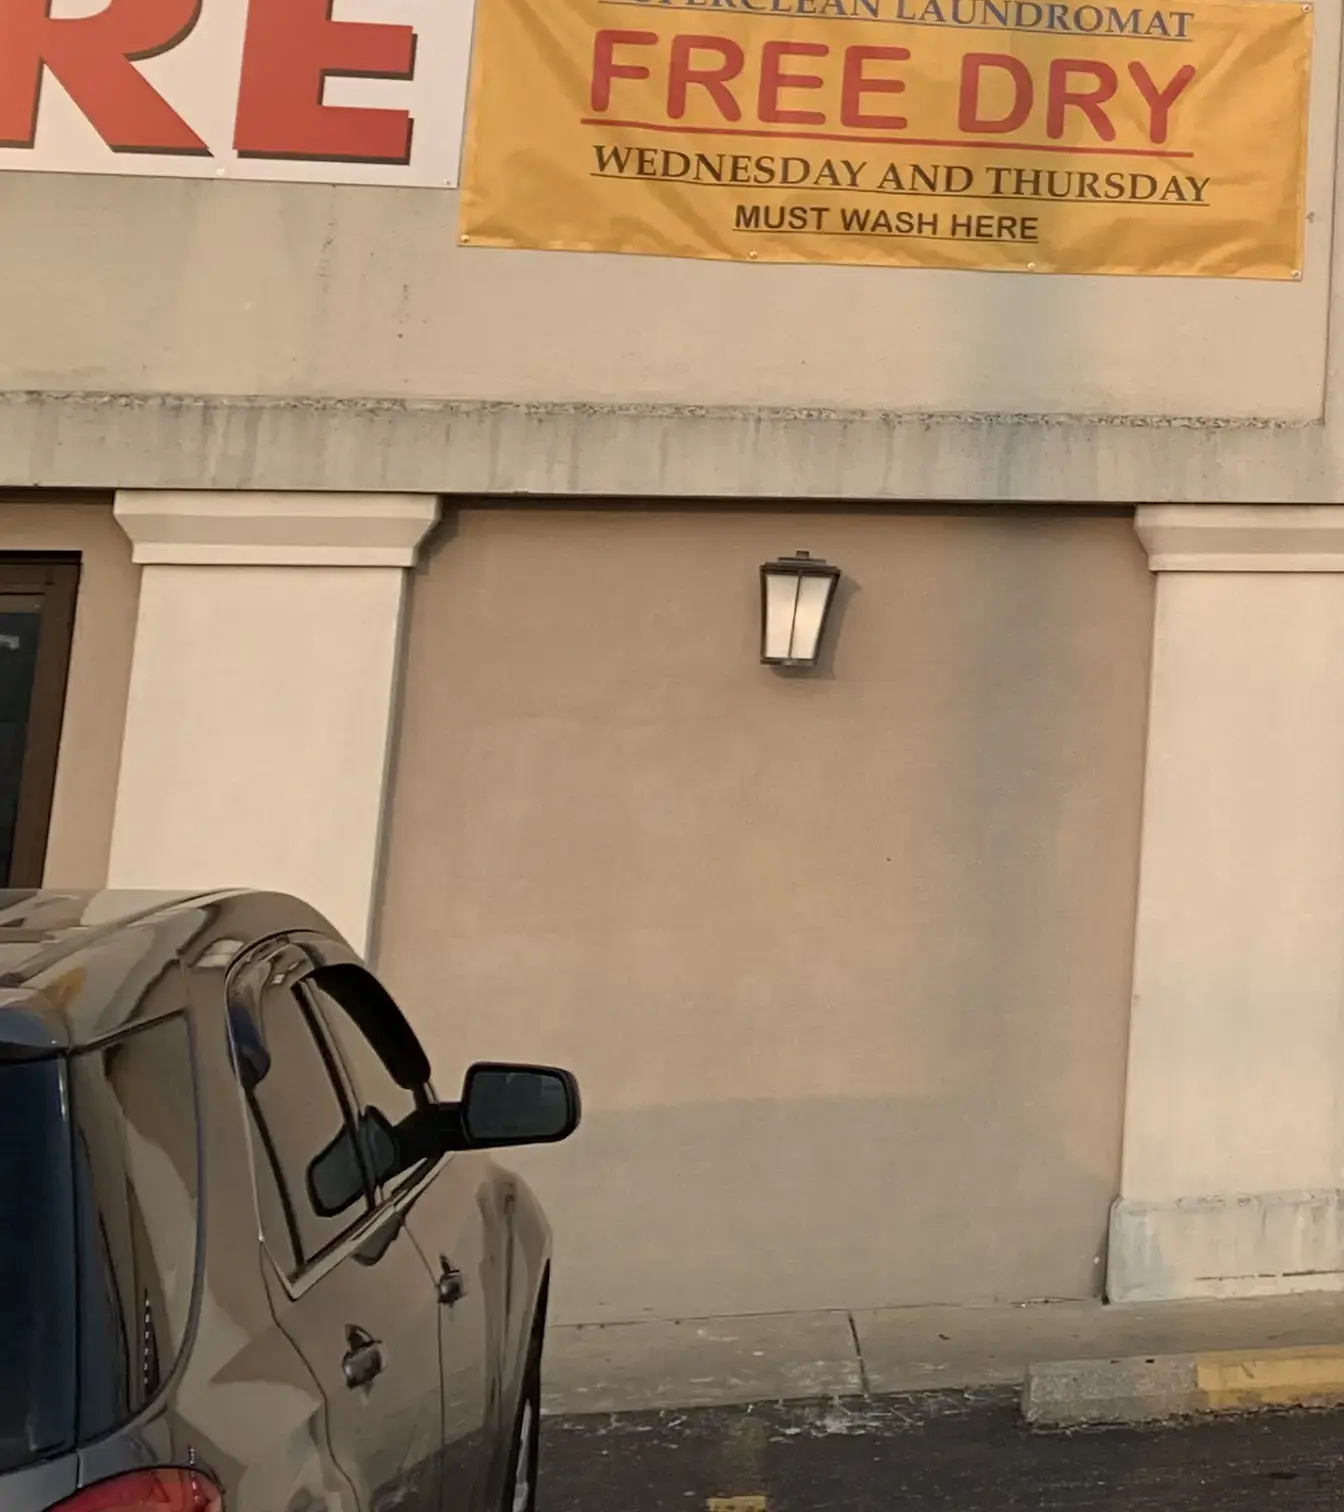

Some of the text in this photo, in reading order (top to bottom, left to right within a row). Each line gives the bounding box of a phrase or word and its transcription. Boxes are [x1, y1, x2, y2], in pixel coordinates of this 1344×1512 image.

[590, 28, 1197, 145] FREE DRY
[592, 144, 1212, 203] WEDNESDAY AND THURSDAY
[735, 204, 1040, 240] MUST WASH HERE
